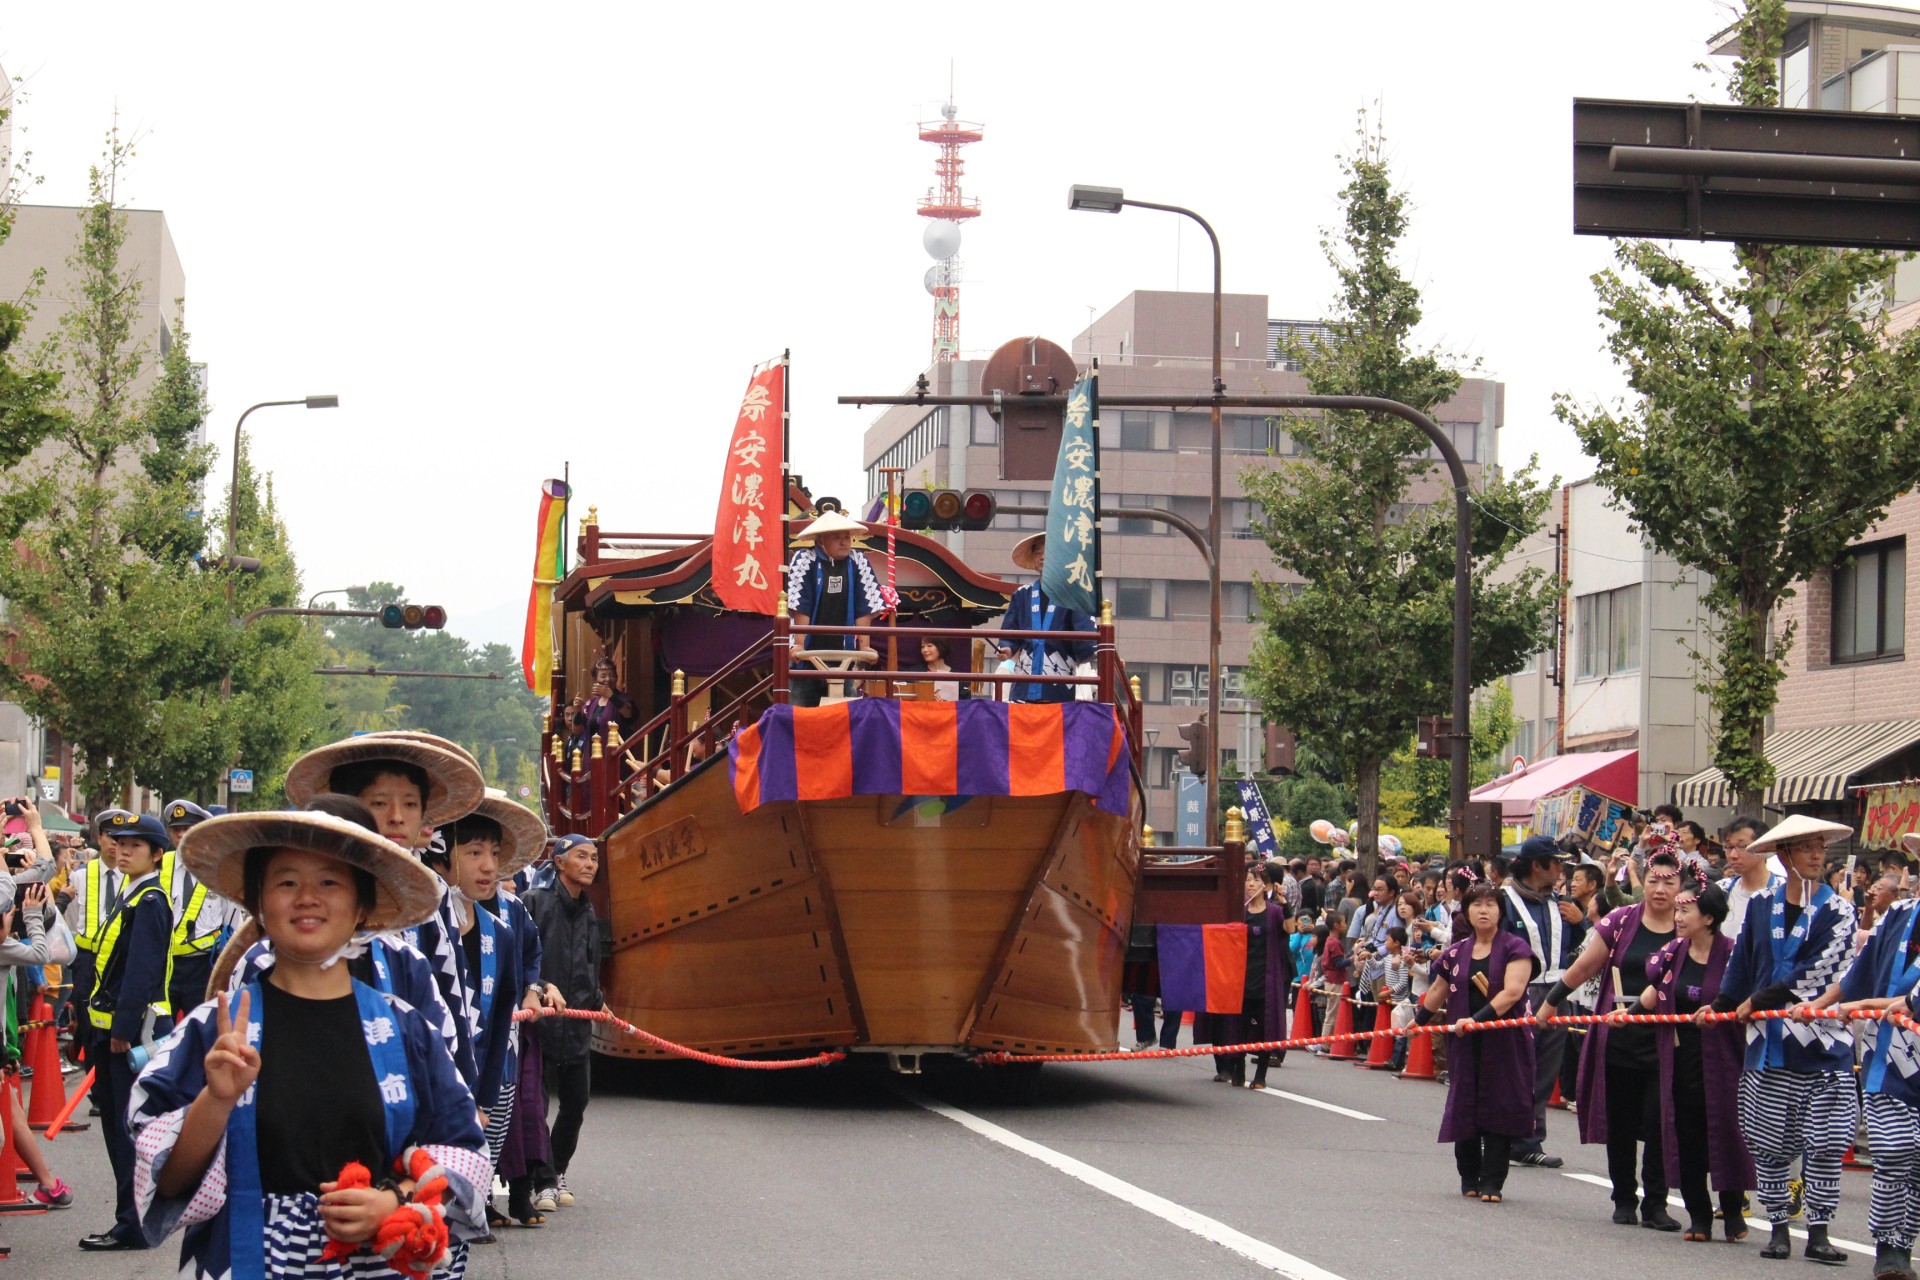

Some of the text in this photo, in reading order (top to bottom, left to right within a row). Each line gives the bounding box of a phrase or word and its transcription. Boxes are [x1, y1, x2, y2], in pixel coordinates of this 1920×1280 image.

[732, 385, 772, 590] 祭安濃津丸
[481, 933, 494, 996] 津市
[363, 1016, 408, 1104] 津市
